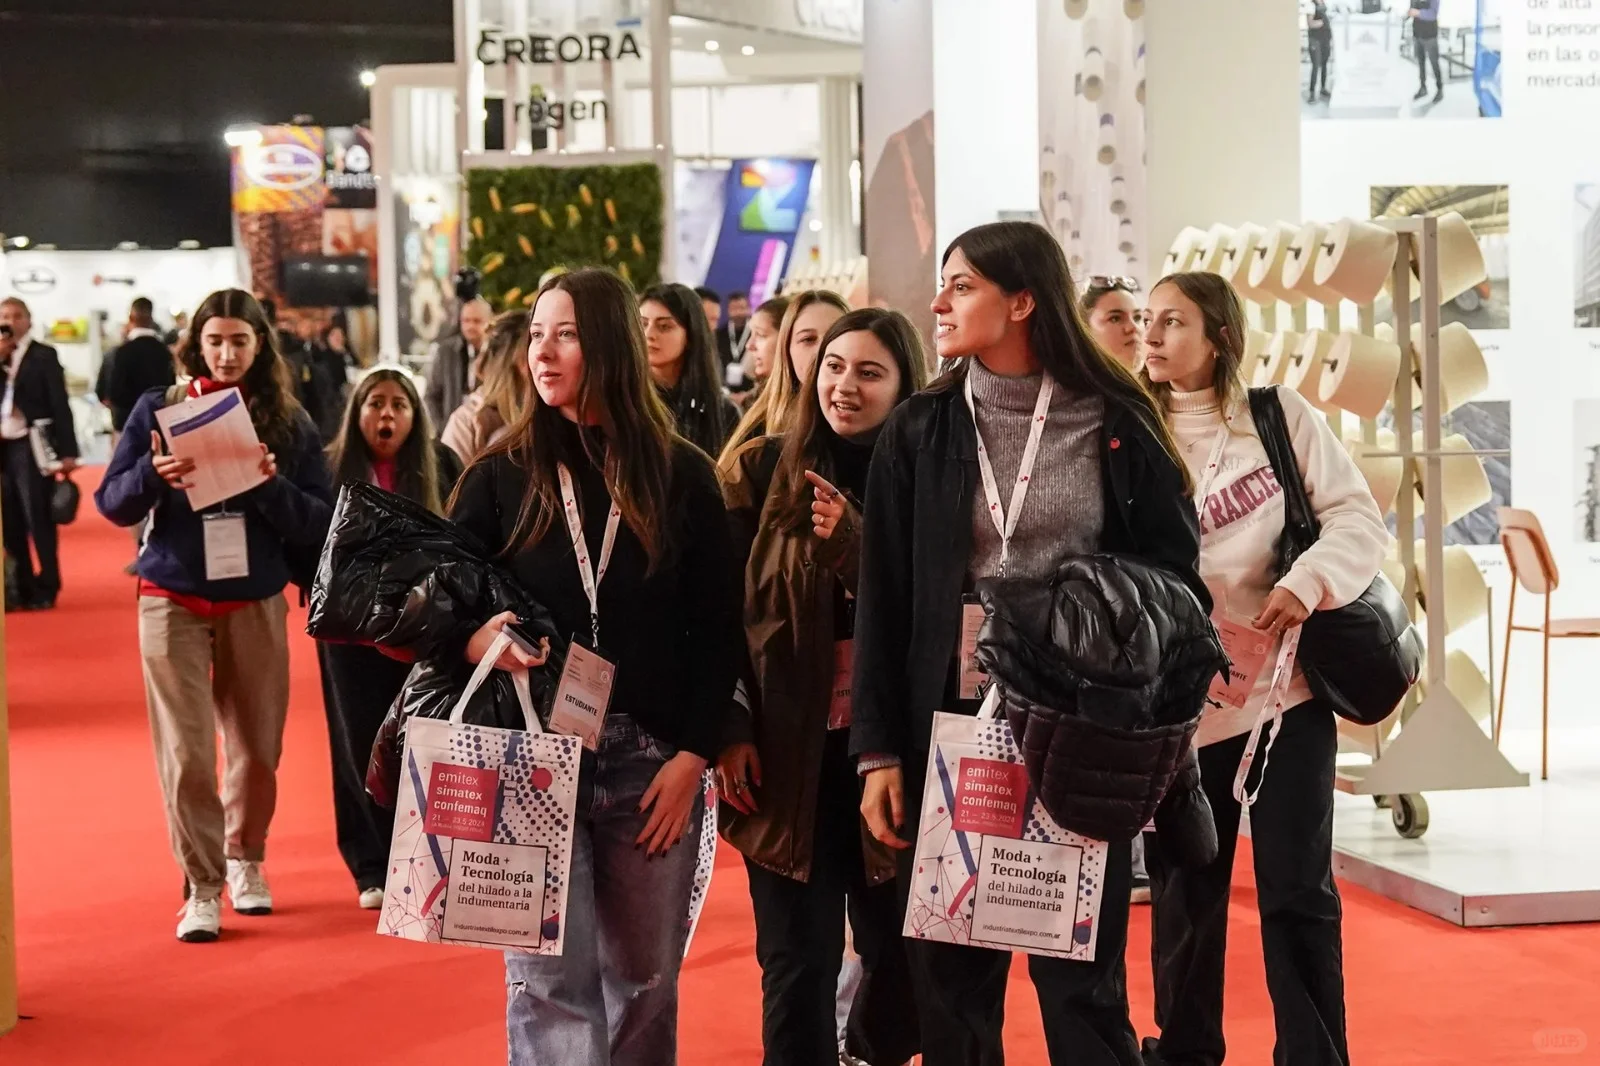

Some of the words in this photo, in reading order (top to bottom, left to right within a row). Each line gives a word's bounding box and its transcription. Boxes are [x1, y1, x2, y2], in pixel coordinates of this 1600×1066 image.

[1527, 19, 1542, 36] la
[1527, 48, 1549, 62] en
[1556, 44, 1582, 62] las
[565, 693, 598, 717] ESTUDIANTE
[438, 771, 479, 786] emitex
[966, 766, 1009, 781] emitex
[436, 784, 483, 801] simatex
[964, 780, 1013, 796] simatex
[433, 800, 487, 818] confemaq
[962, 796, 1017, 814] confemaq
[462, 850, 500, 866] Moda
[992, 848, 1031, 863] Moda
[461, 865, 534, 884] Tecnología
[990, 863, 1067, 884] Tecnología
[458, 882, 475, 893] del
[478, 883, 511, 898] hilado
[513, 890, 520, 898] a
[522, 887, 532, 899] la
[988, 880, 1005, 892] del
[1008, 882, 1042, 896] hilado
[1045, 889, 1052, 898] a
[1054, 887, 1064, 899] la
[457, 894, 530, 911] indumentaria
[986, 893, 1062, 912] indumentaria
